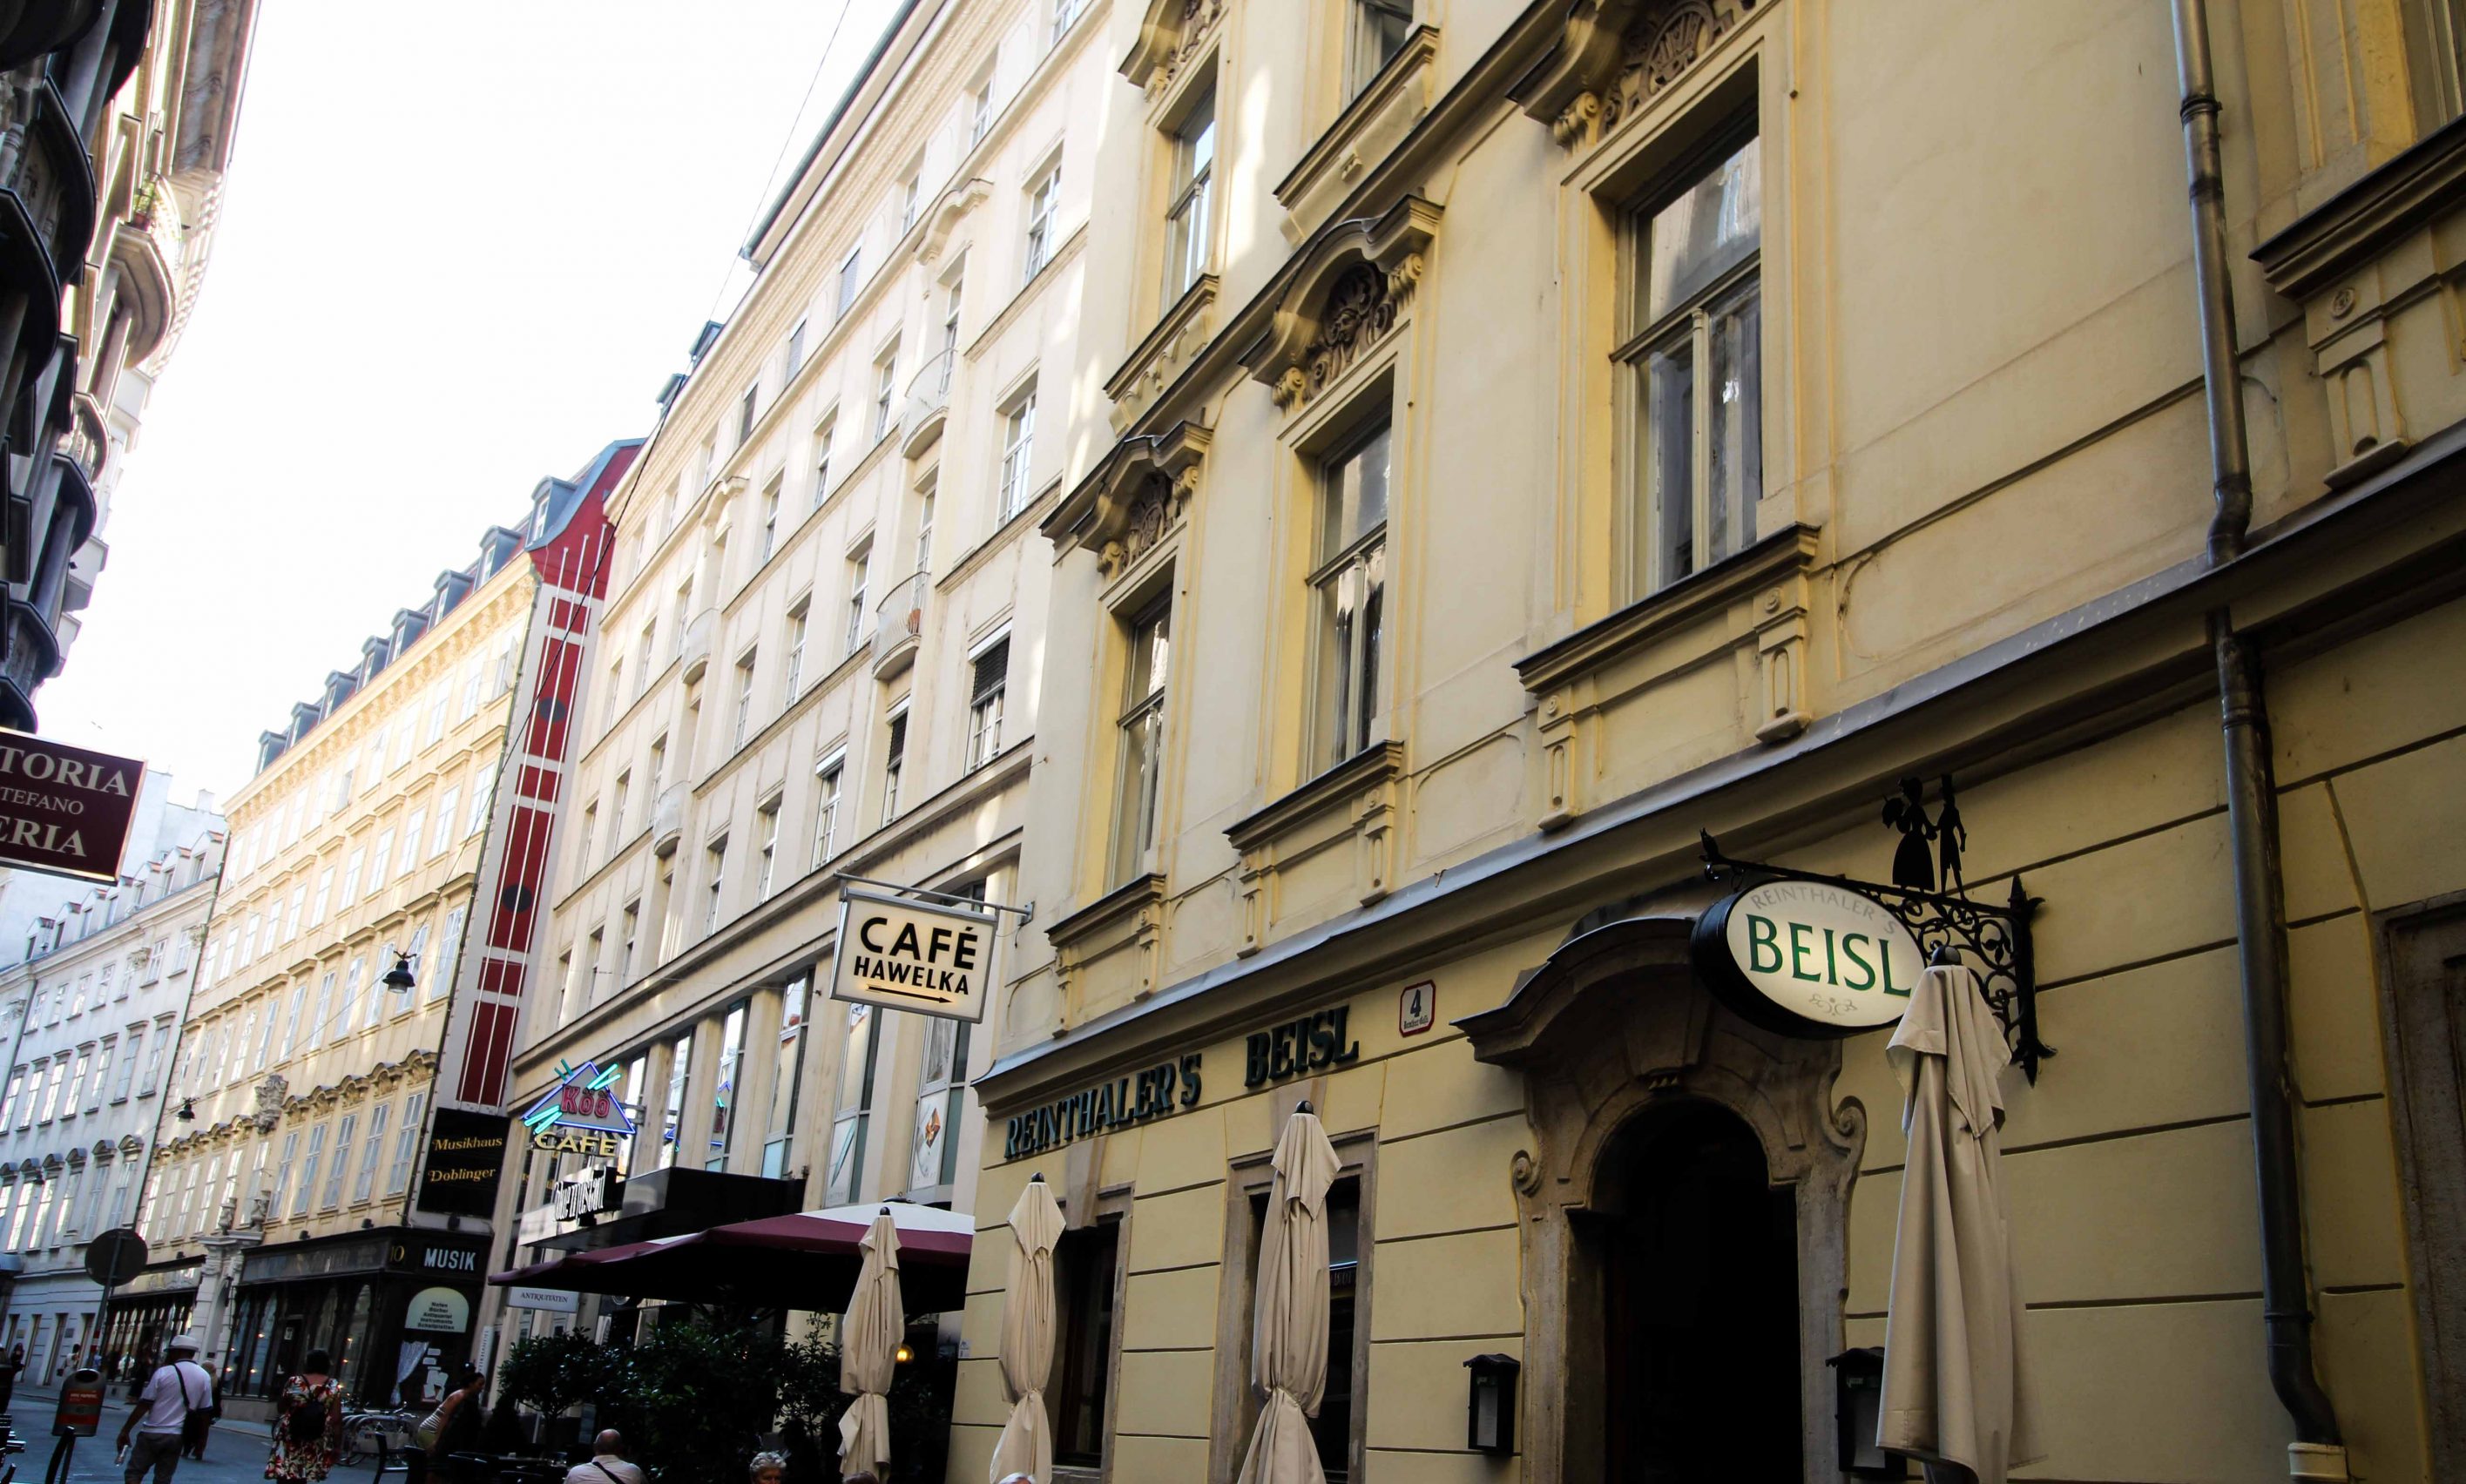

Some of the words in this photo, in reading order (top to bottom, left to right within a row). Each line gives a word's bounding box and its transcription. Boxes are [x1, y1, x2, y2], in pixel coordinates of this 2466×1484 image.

[1, 786, 84, 815] TEFANO
[1750, 886, 1897, 934] REINTHALER'S
[861, 917, 977, 970] CAFÉ
[1746, 914, 1911, 998] BEISL
[854, 956, 969, 995] HAWELKA
[1410, 989, 1422, 1017] 4
[1004, 1053, 1202, 1159] REINTHALER'S
[1244, 1004, 1360, 1087] BEISL
[432, 1137, 503, 1150] Musikhaus
[428, 1169, 496, 1182] Doblinger
[424, 1248, 476, 1271] MUSIK
